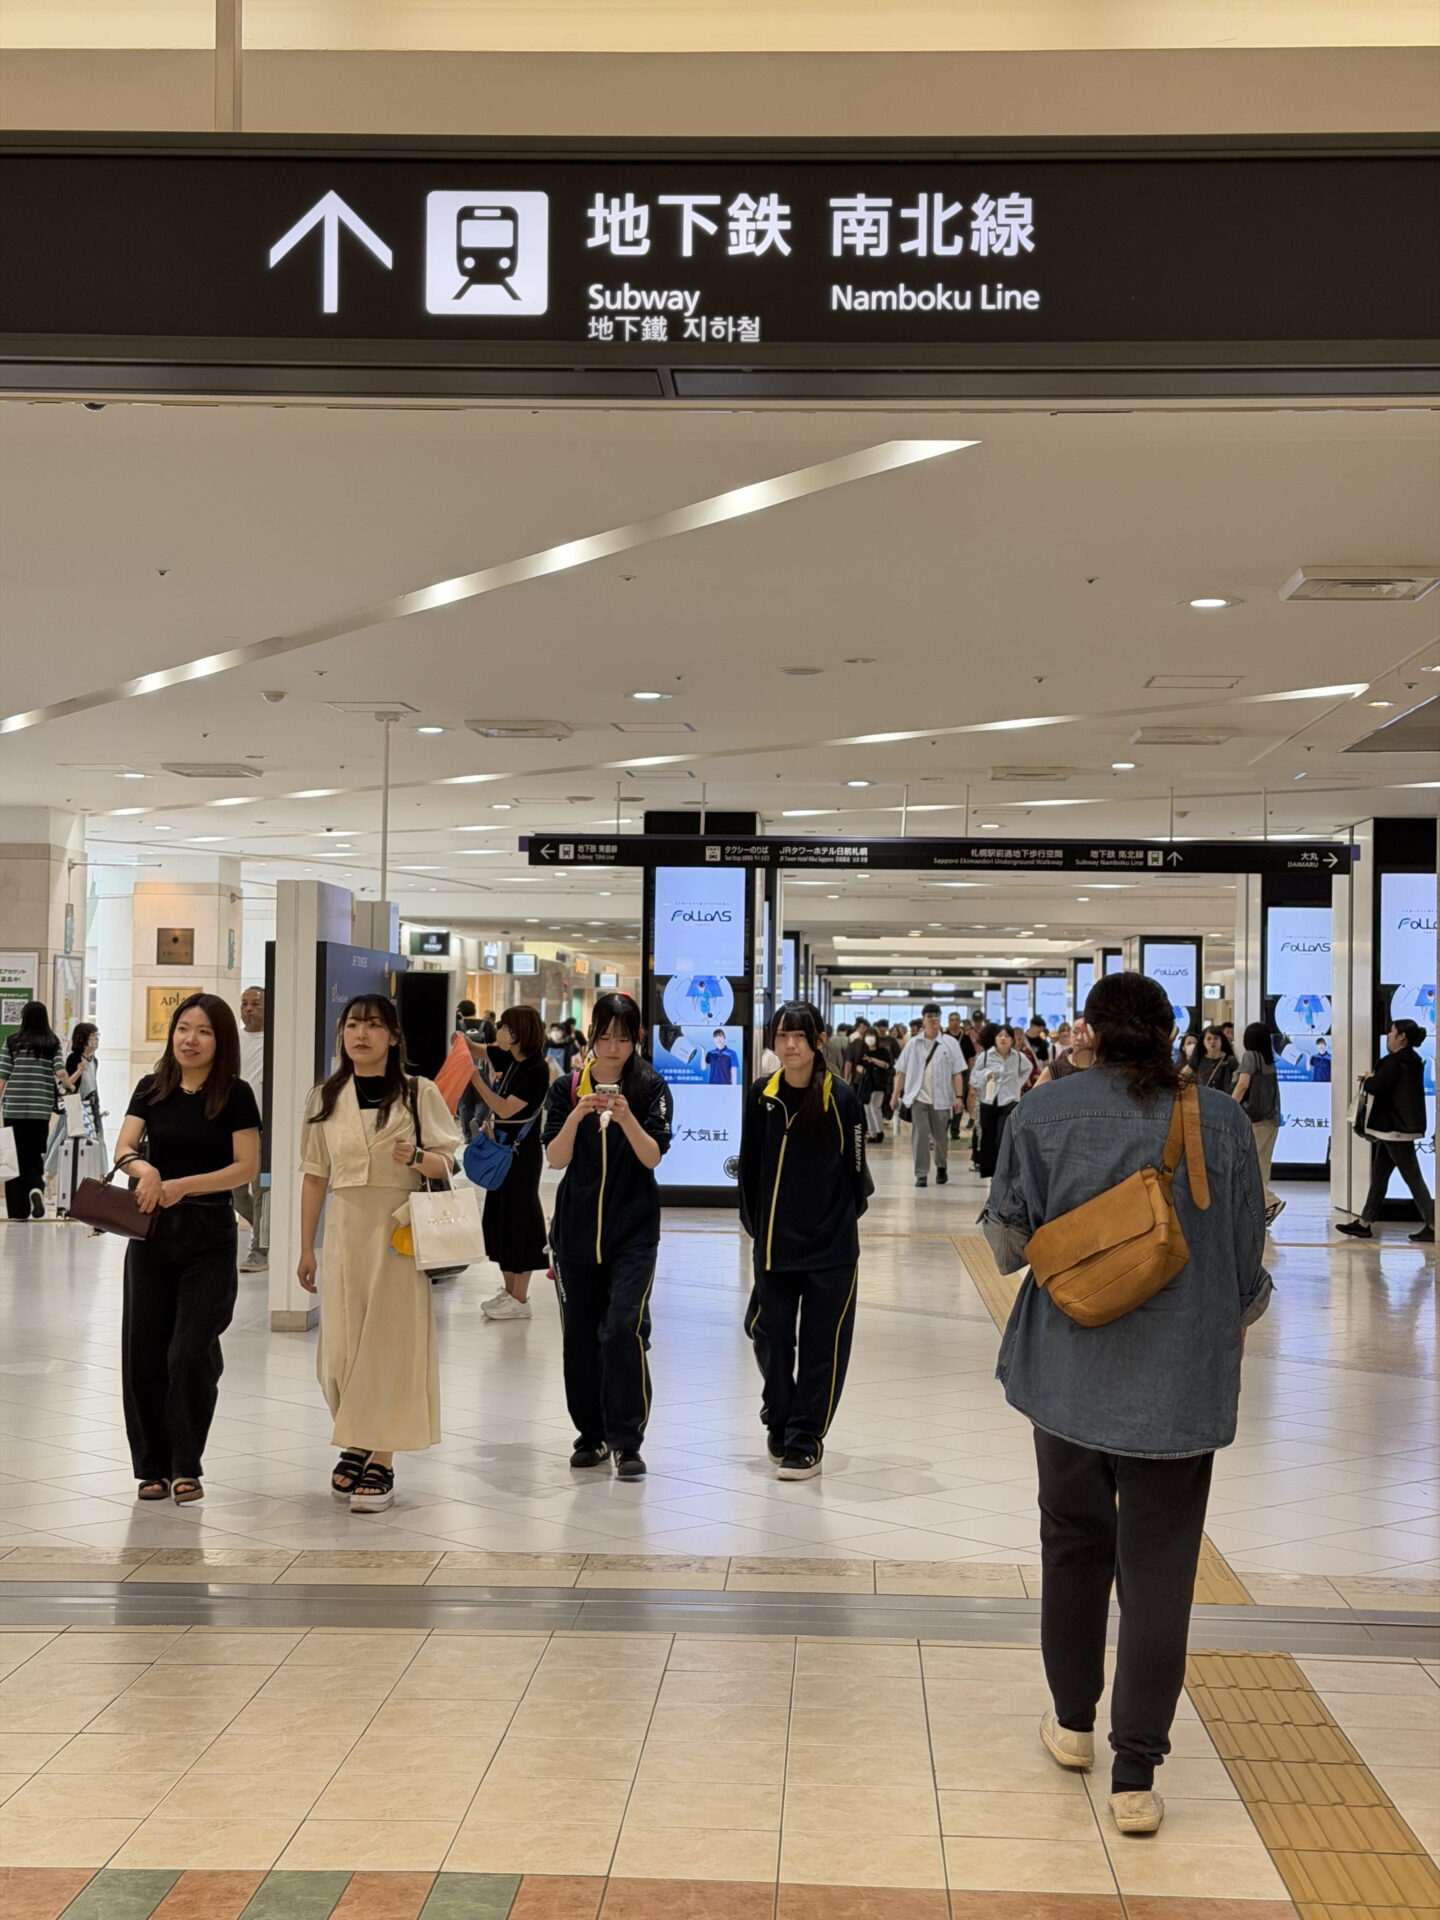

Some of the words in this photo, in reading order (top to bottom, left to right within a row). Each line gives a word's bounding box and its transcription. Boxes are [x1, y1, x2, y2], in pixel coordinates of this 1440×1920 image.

[587, 193, 792, 257] 地下鉄
[829, 193, 1035, 257] 南北線
[588, 283, 701, 317] Subway
[831, 283, 972, 311] Namboku
[981, 284, 1040, 310] Line
[588, 315, 668, 342] 地下鐵
[683, 315, 761, 342] 지하철
[724, 846, 769, 854] タクシーのりば
[1089, 849, 1115, 859] 地下鉄
[1118, 850, 1144, 859] 南北線
[1301, 852, 1319, 861] 大丸
[1291, 1117, 1330, 1128] 大気社
[682, 1128, 729, 1142] 大気社
